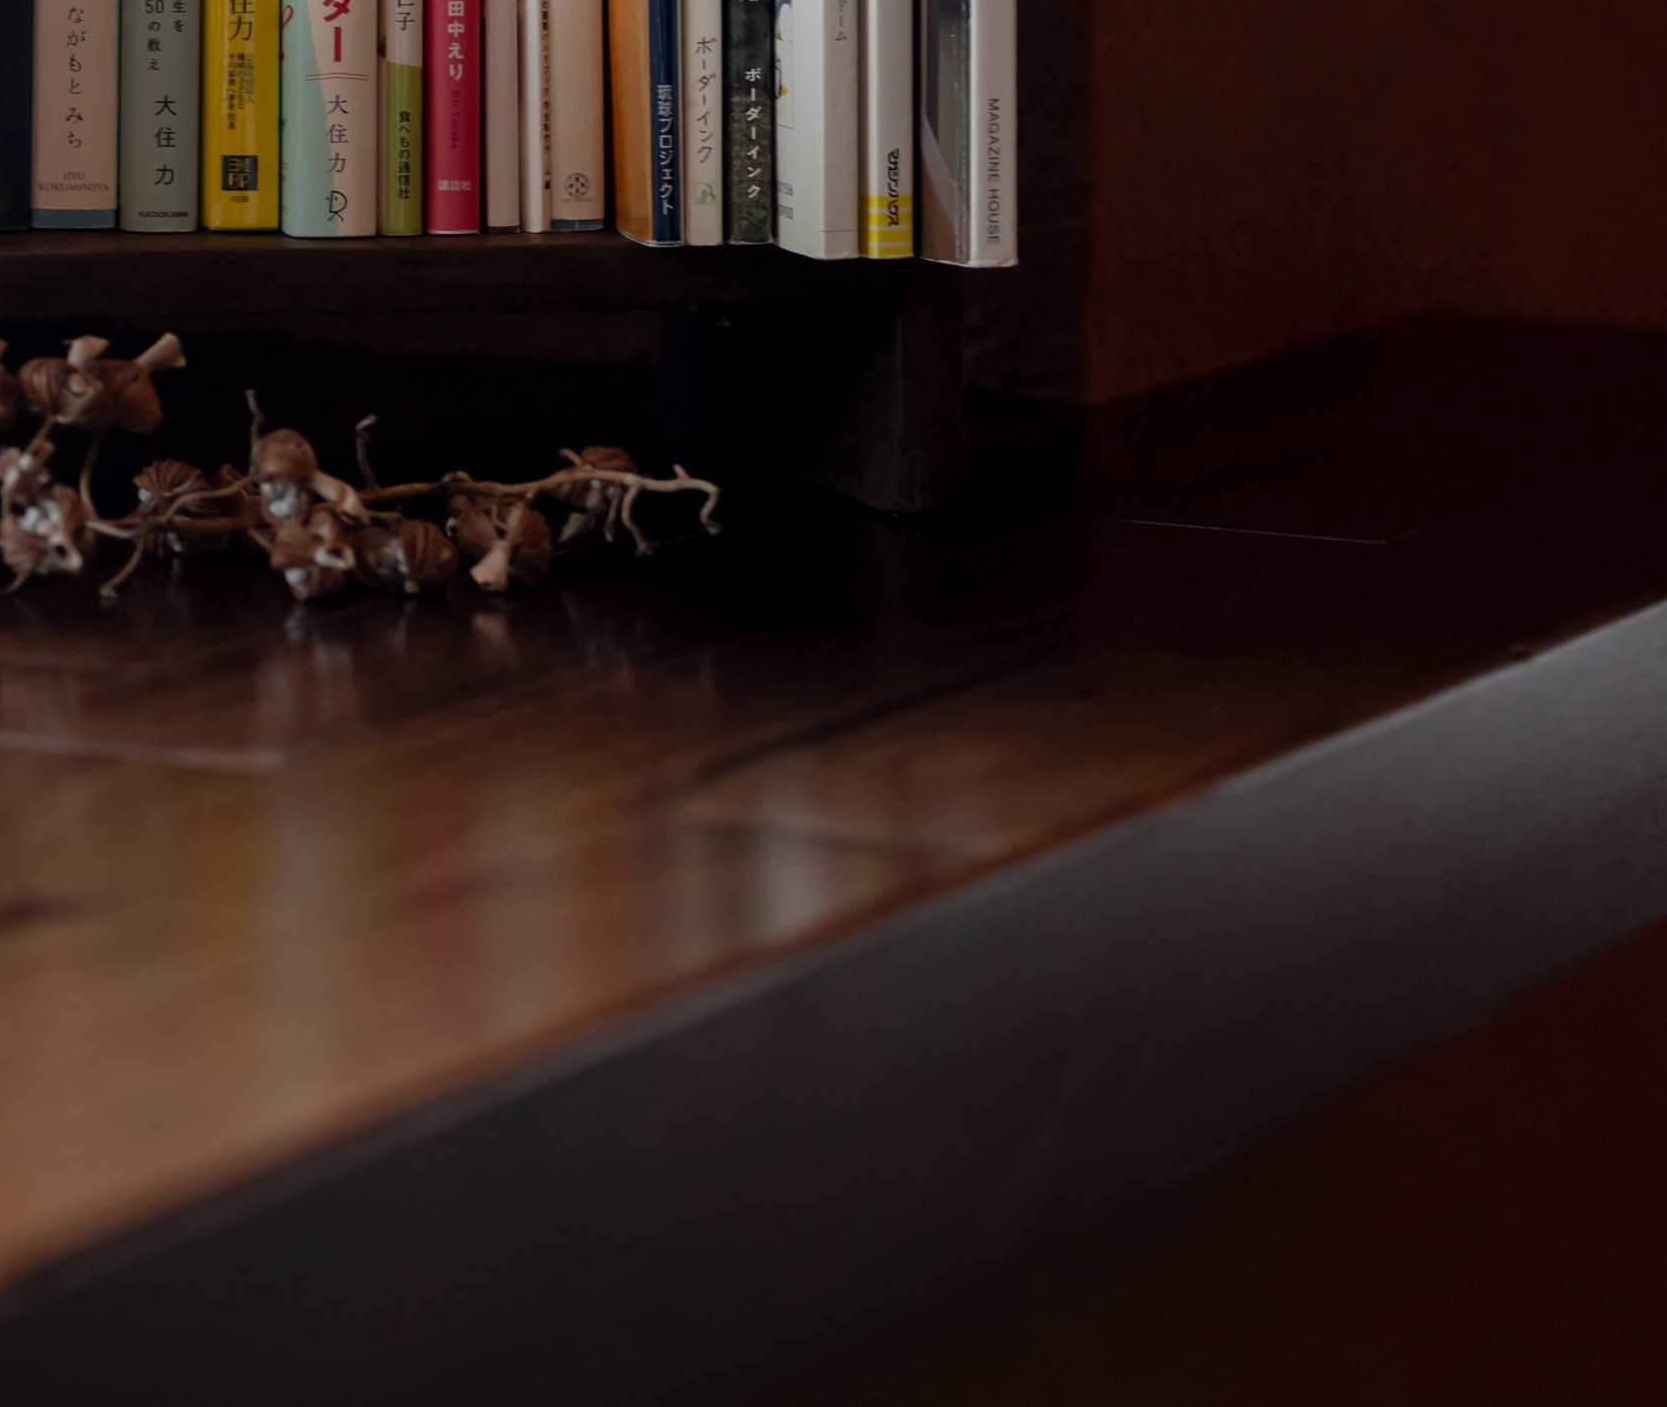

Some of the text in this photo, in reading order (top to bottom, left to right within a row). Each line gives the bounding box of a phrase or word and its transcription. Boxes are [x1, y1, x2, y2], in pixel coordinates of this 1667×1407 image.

[447, 0, 466, 81] 田中えり
[694, 36, 717, 164] ボーダーインク
[153, 95, 178, 186] 大住力
[327, 94, 350, 174] 大住力
[656, 84, 675, 216] 琉球プロジェクト
[744, 68, 763, 199] ボーダーインク
[986, 98, 1000, 246] MAGAZINE HOUSE
